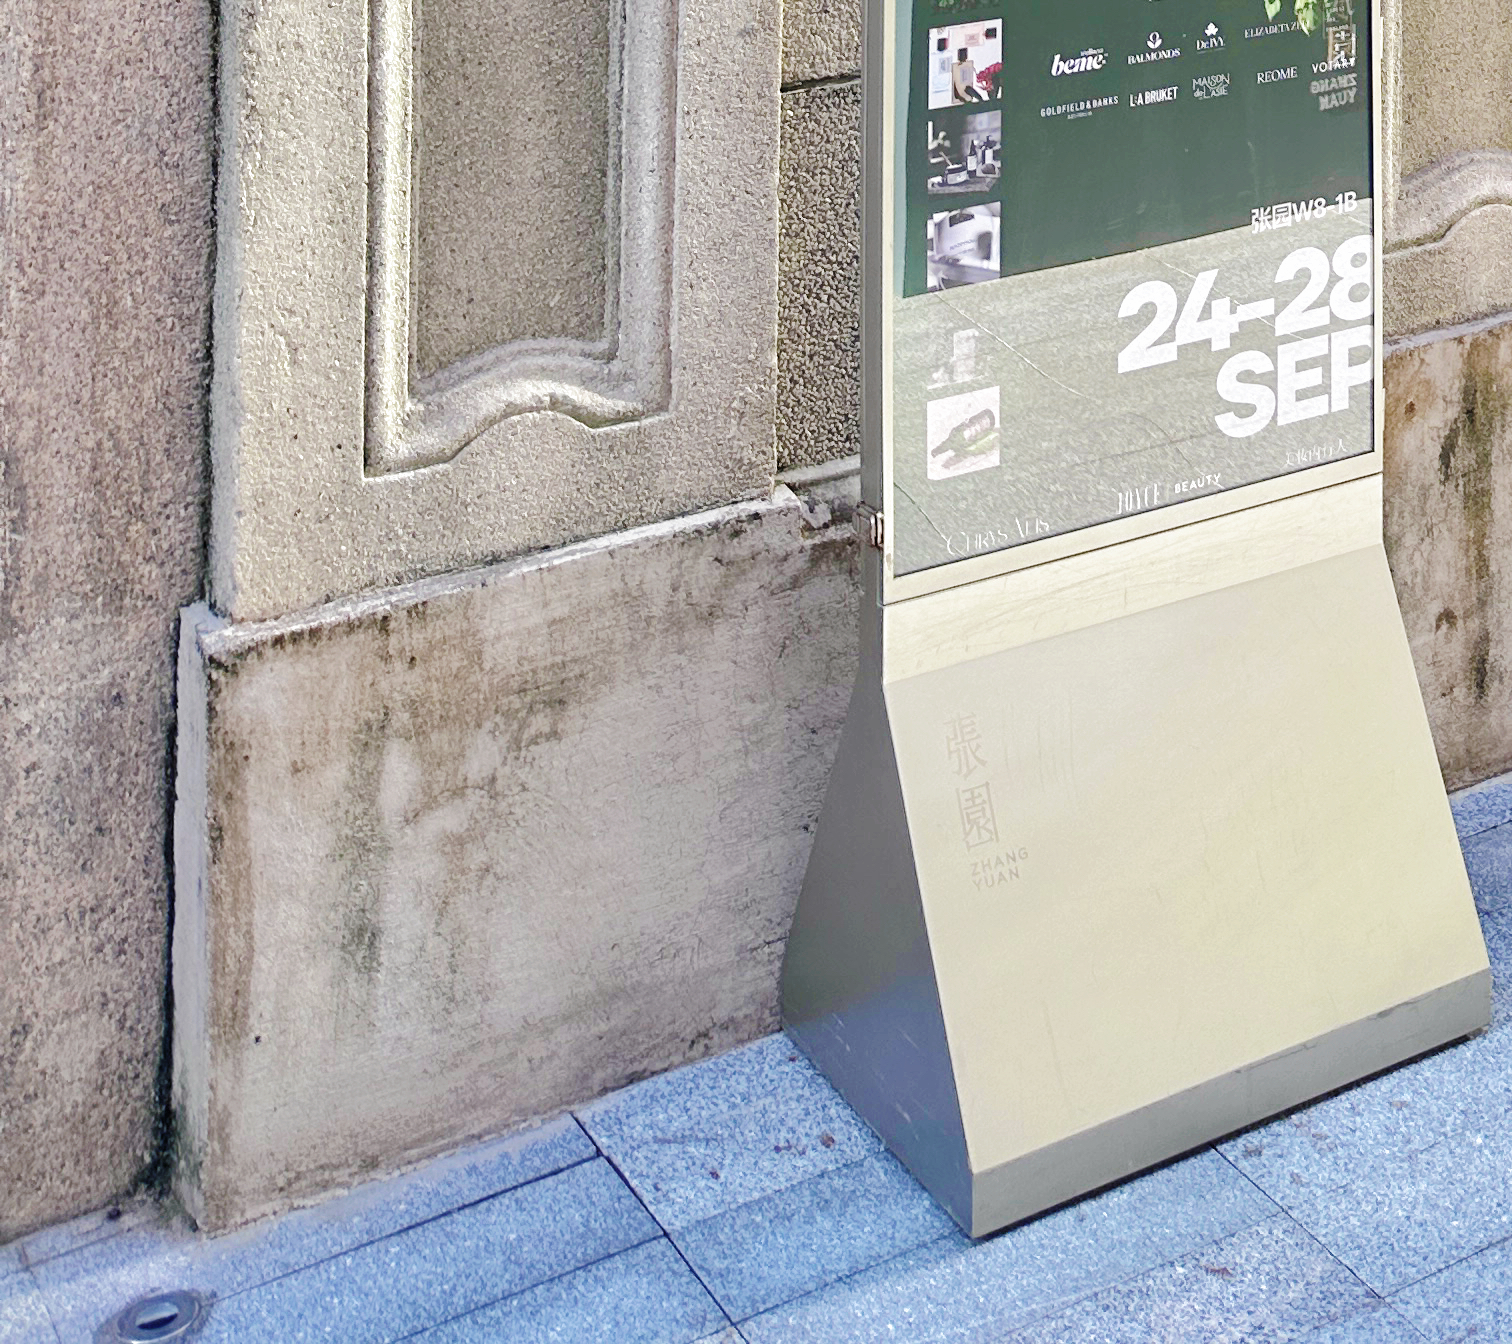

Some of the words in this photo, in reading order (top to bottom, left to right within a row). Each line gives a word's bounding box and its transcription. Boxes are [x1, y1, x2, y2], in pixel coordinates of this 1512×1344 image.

[1192, 72, 1230, 90] MAISON
[1250, 190, 1359, 235] 张园W8-1B
[1117, 235, 1373, 374] 24-28
[1214, 325, 1373, 439] SEP
[1174, 473, 1221, 494] BEAUTY
[943, 711, 1000, 853] 張園
[970, 846, 1029, 877] ZHANG
[972, 866, 1020, 892] YUAN
